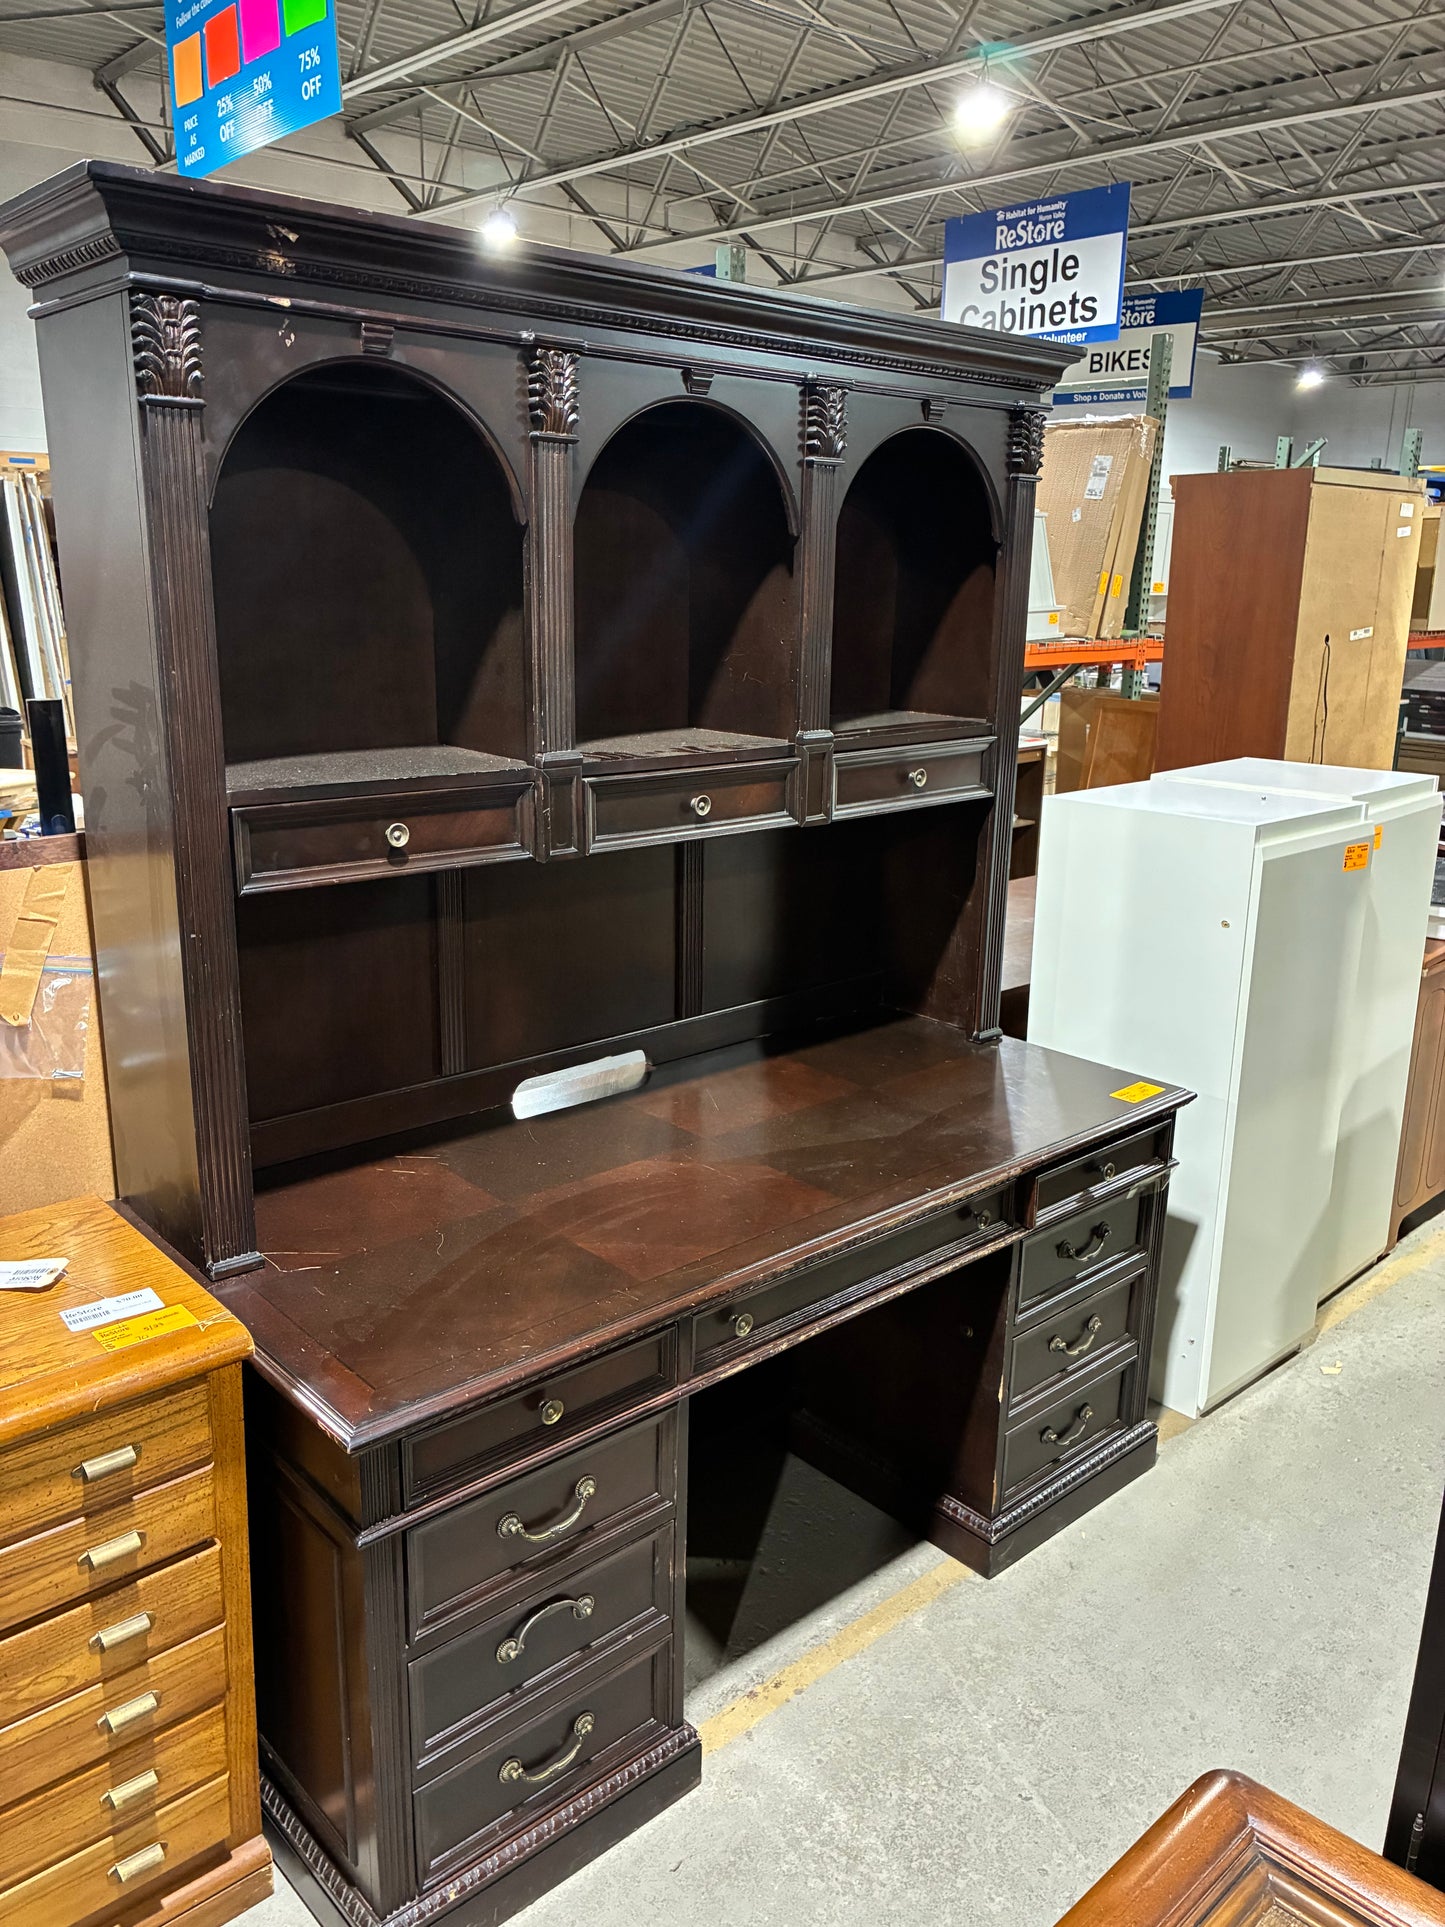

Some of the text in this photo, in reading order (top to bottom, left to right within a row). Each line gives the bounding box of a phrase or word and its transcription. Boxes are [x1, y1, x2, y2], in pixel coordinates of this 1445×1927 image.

[176, 10, 192, 29] Follow
[191, 2, 200, 16] the
[298, 46, 321, 72] 75%
[253, 71, 273, 96] 50%
[302, 75, 322, 100] OFF
[216, 93, 234, 118] 25%
[183, 114, 199, 132] PRICE
[219, 120, 235, 143] OFF
[189, 133, 197, 147] AS
[183, 146, 206, 168] MARKED
[1005, 200, 1067, 220] Habitat for Humanity
[995, 220, 1065, 250] ReStore
[980, 248, 1080, 295] Single
[960, 290, 1098, 333] Cabinets
[1120, 309, 1155, 327] Store
[1089, 348, 1151, 373] BIKES
[1073, 394, 1092, 403] Shop
[1099, 391, 1125, 400] Donate
